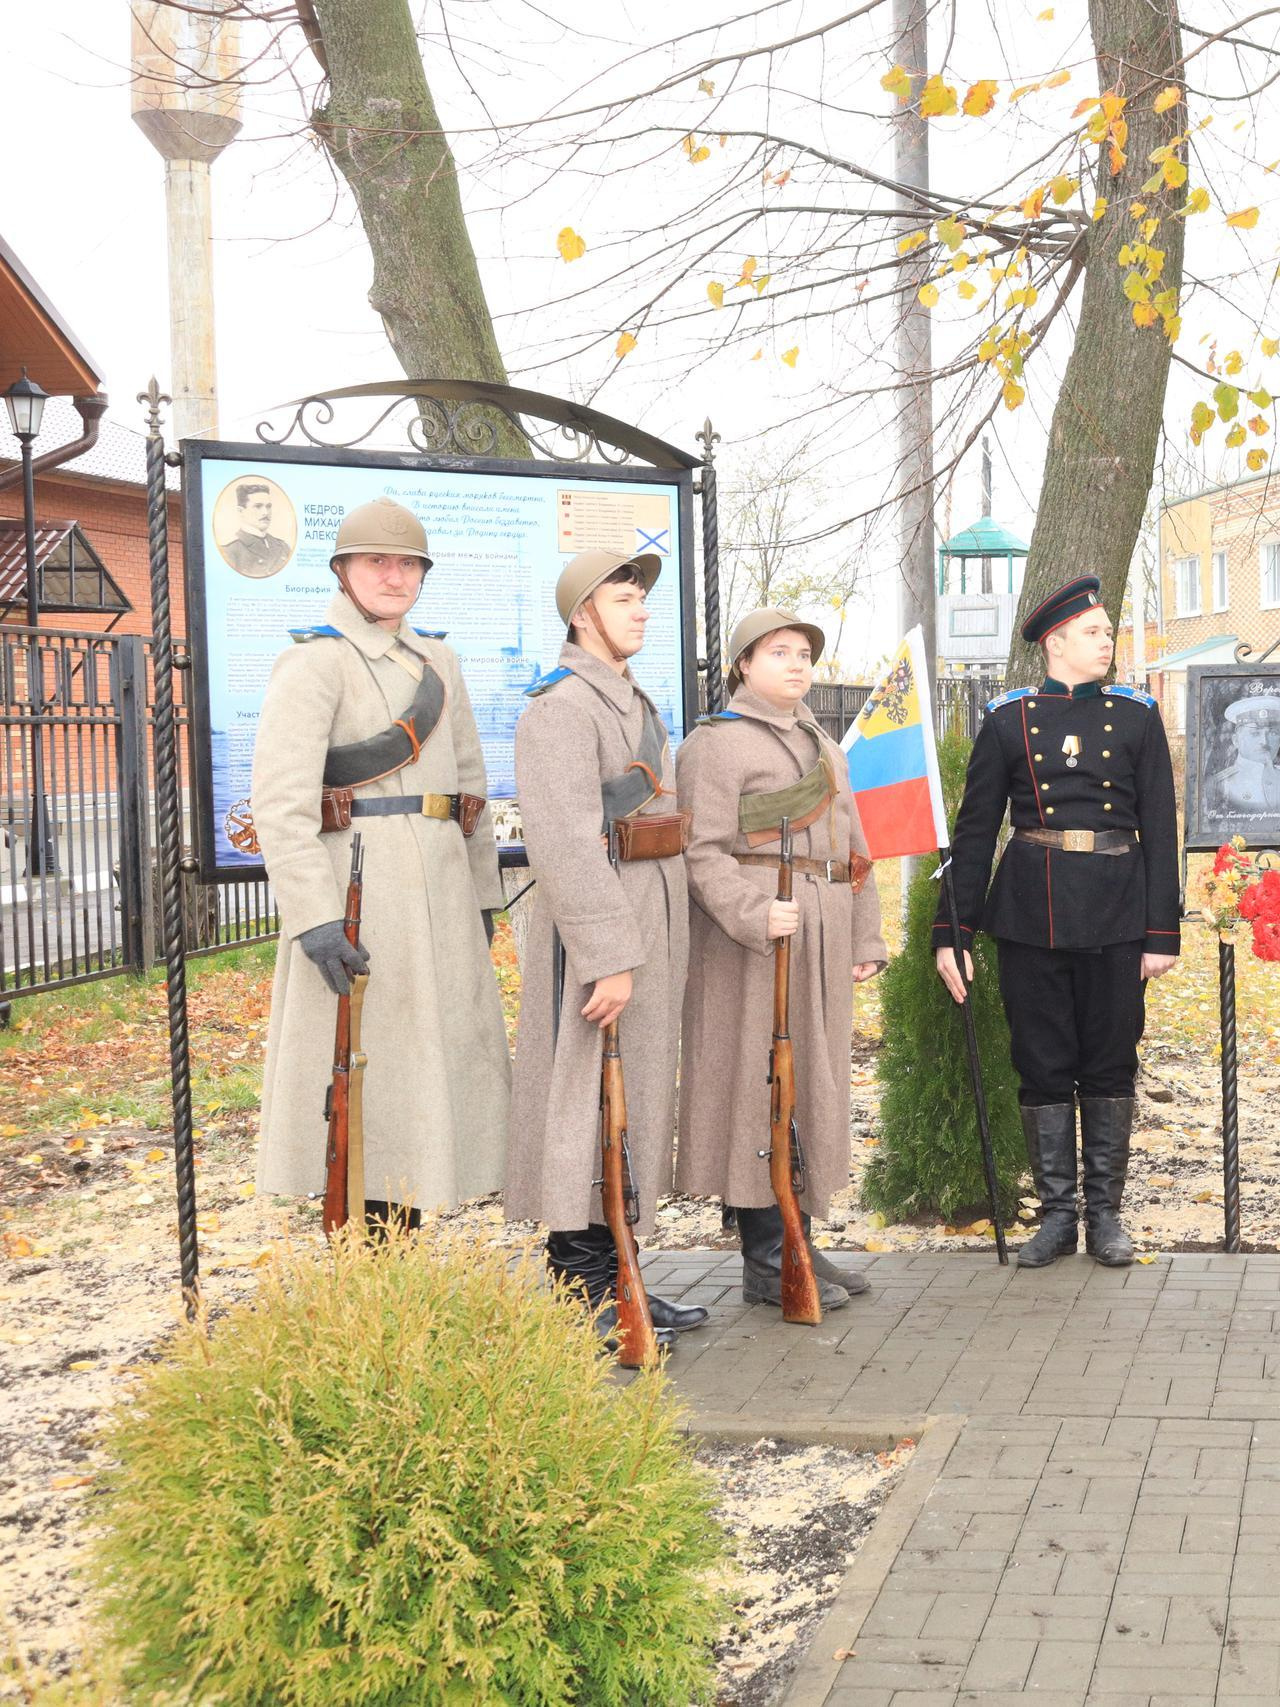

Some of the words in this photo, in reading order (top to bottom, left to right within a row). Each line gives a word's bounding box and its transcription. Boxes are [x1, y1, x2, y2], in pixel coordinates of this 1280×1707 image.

[304, 504, 345, 516] КЕДРОВ
[304, 517, 343, 528] МИХАИ
[458, 552, 482, 561] между
[485, 552, 518, 561] войнами
[285, 584, 331, 594] Биография
[471, 656, 505, 664] мировой
[507, 656, 529, 664] войне
